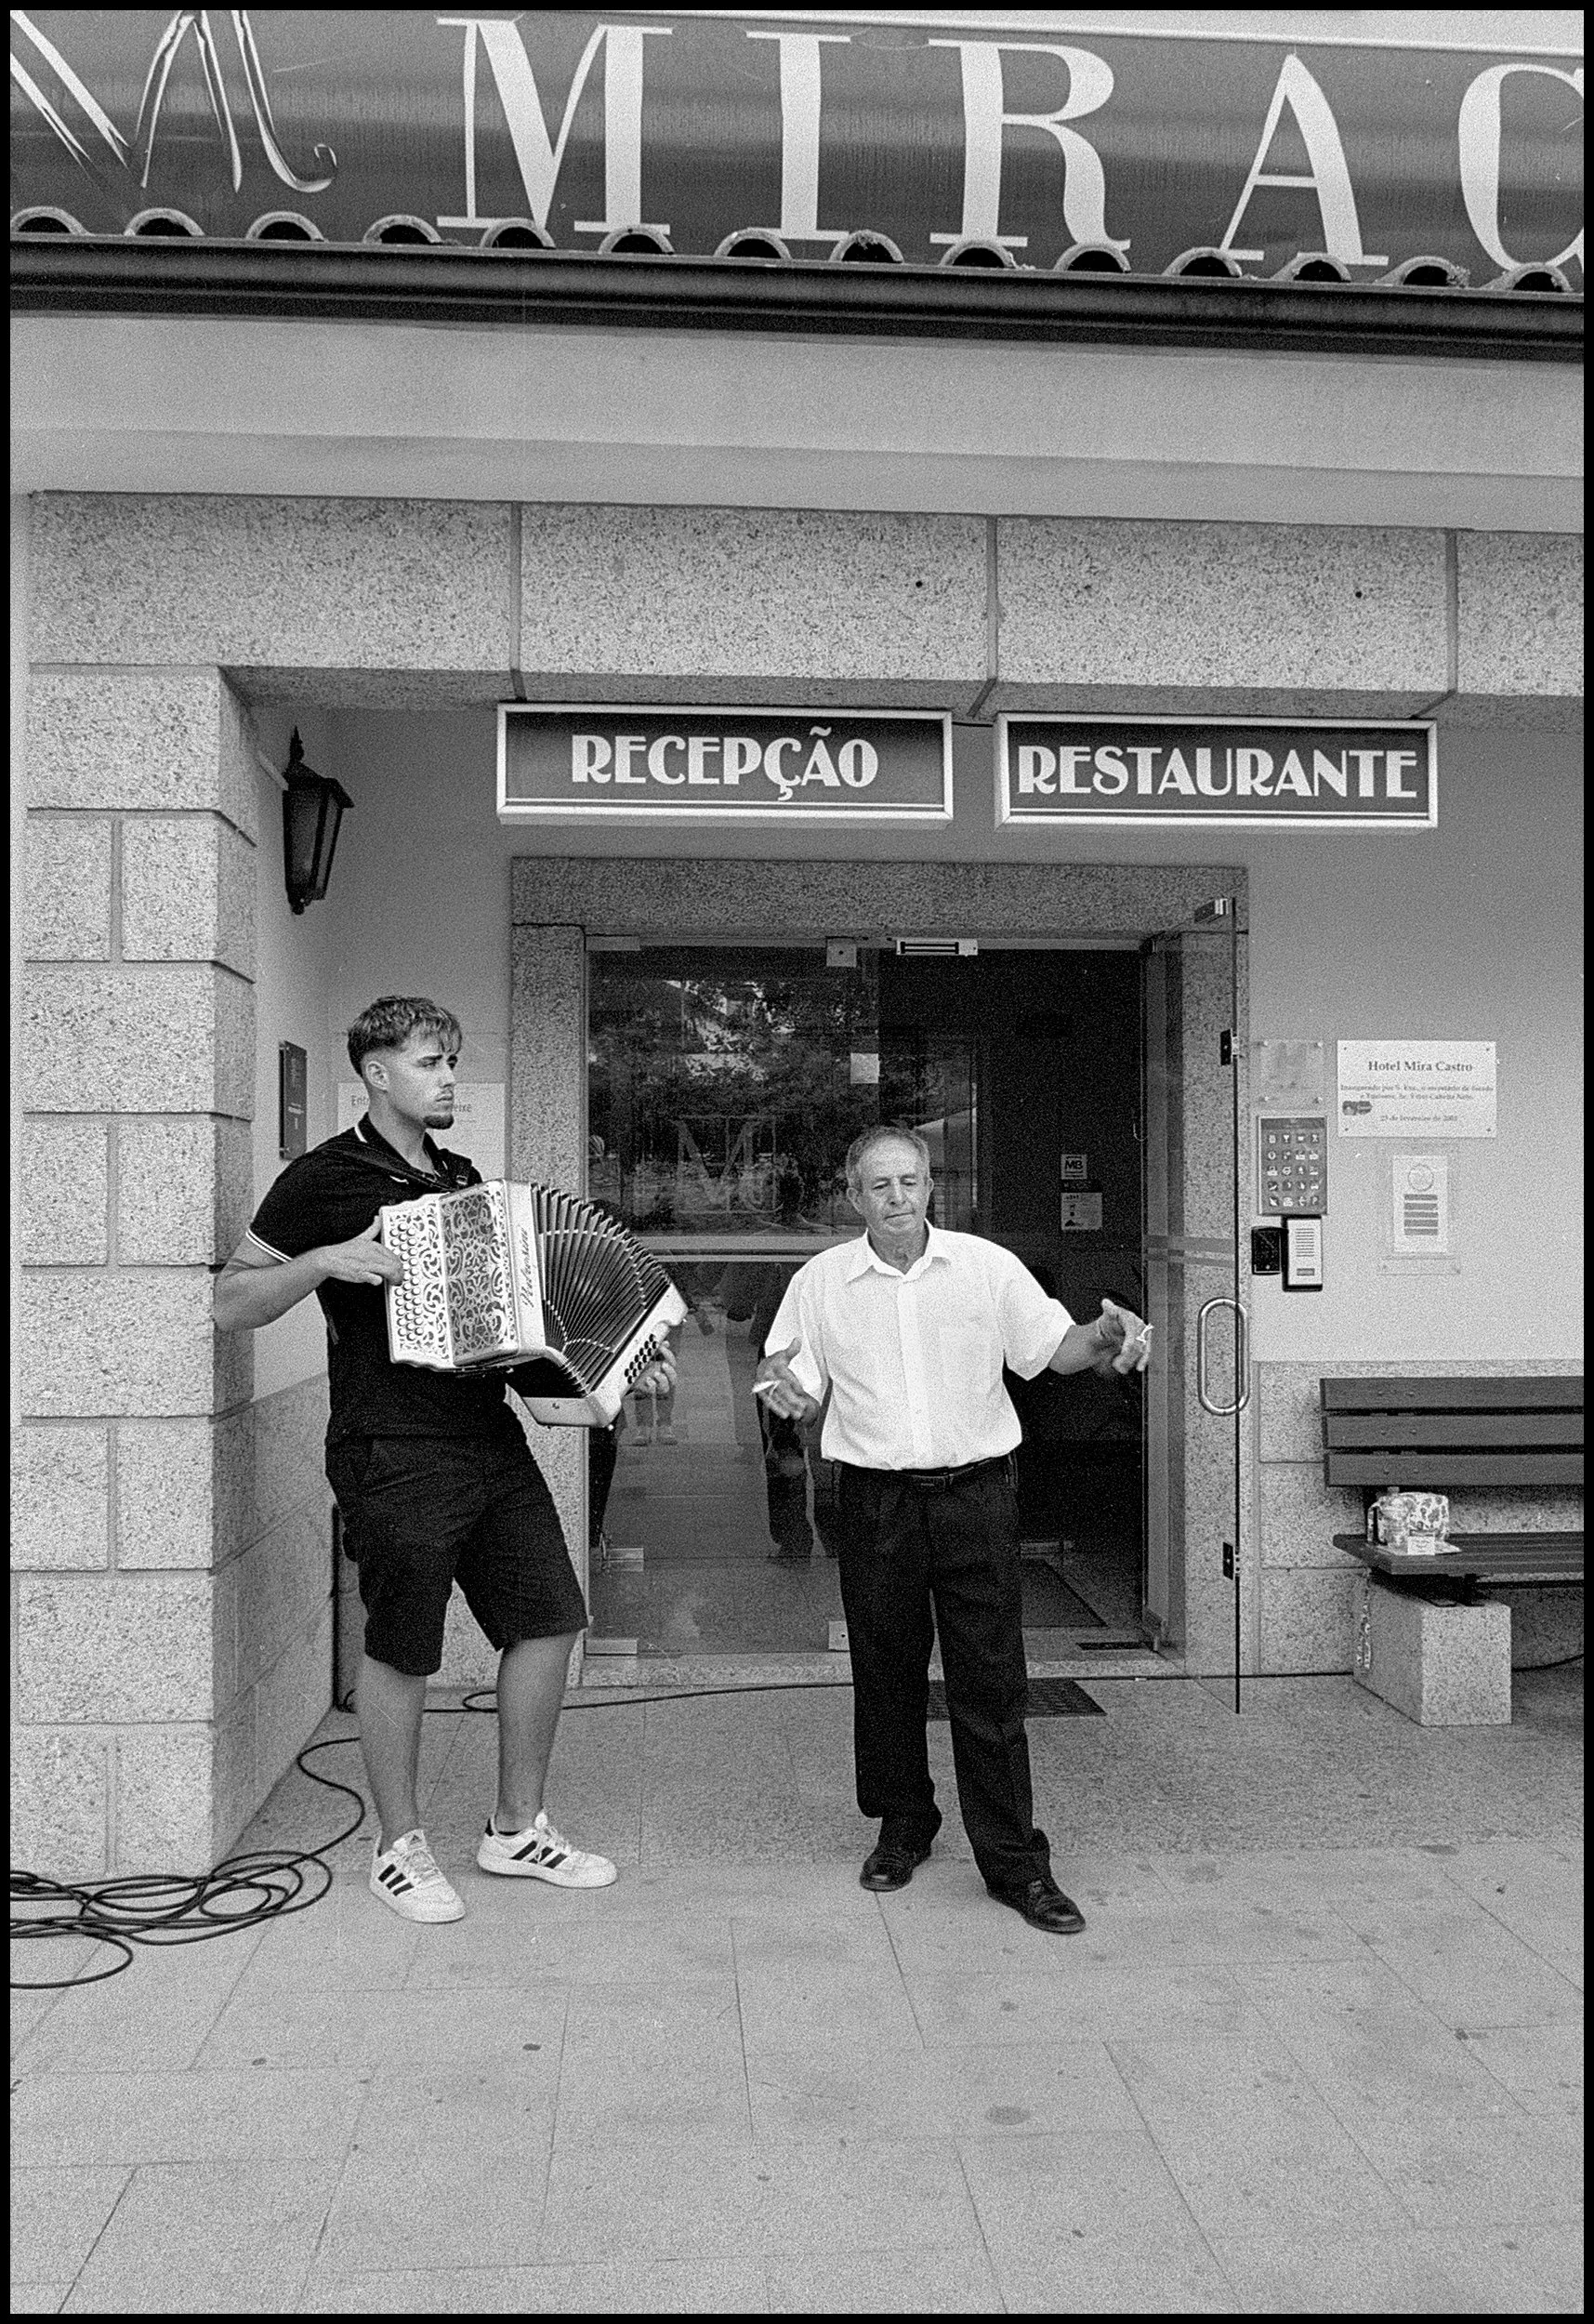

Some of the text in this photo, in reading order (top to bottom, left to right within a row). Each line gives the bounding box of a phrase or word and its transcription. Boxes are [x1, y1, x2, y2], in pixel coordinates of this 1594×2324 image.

[572, 726, 879, 801] RECEPÇÃO
[1017, 745, 1417, 799] RESTAURANTE
[1368, 1060, 1473, 1072] Hotel Mira Castro
